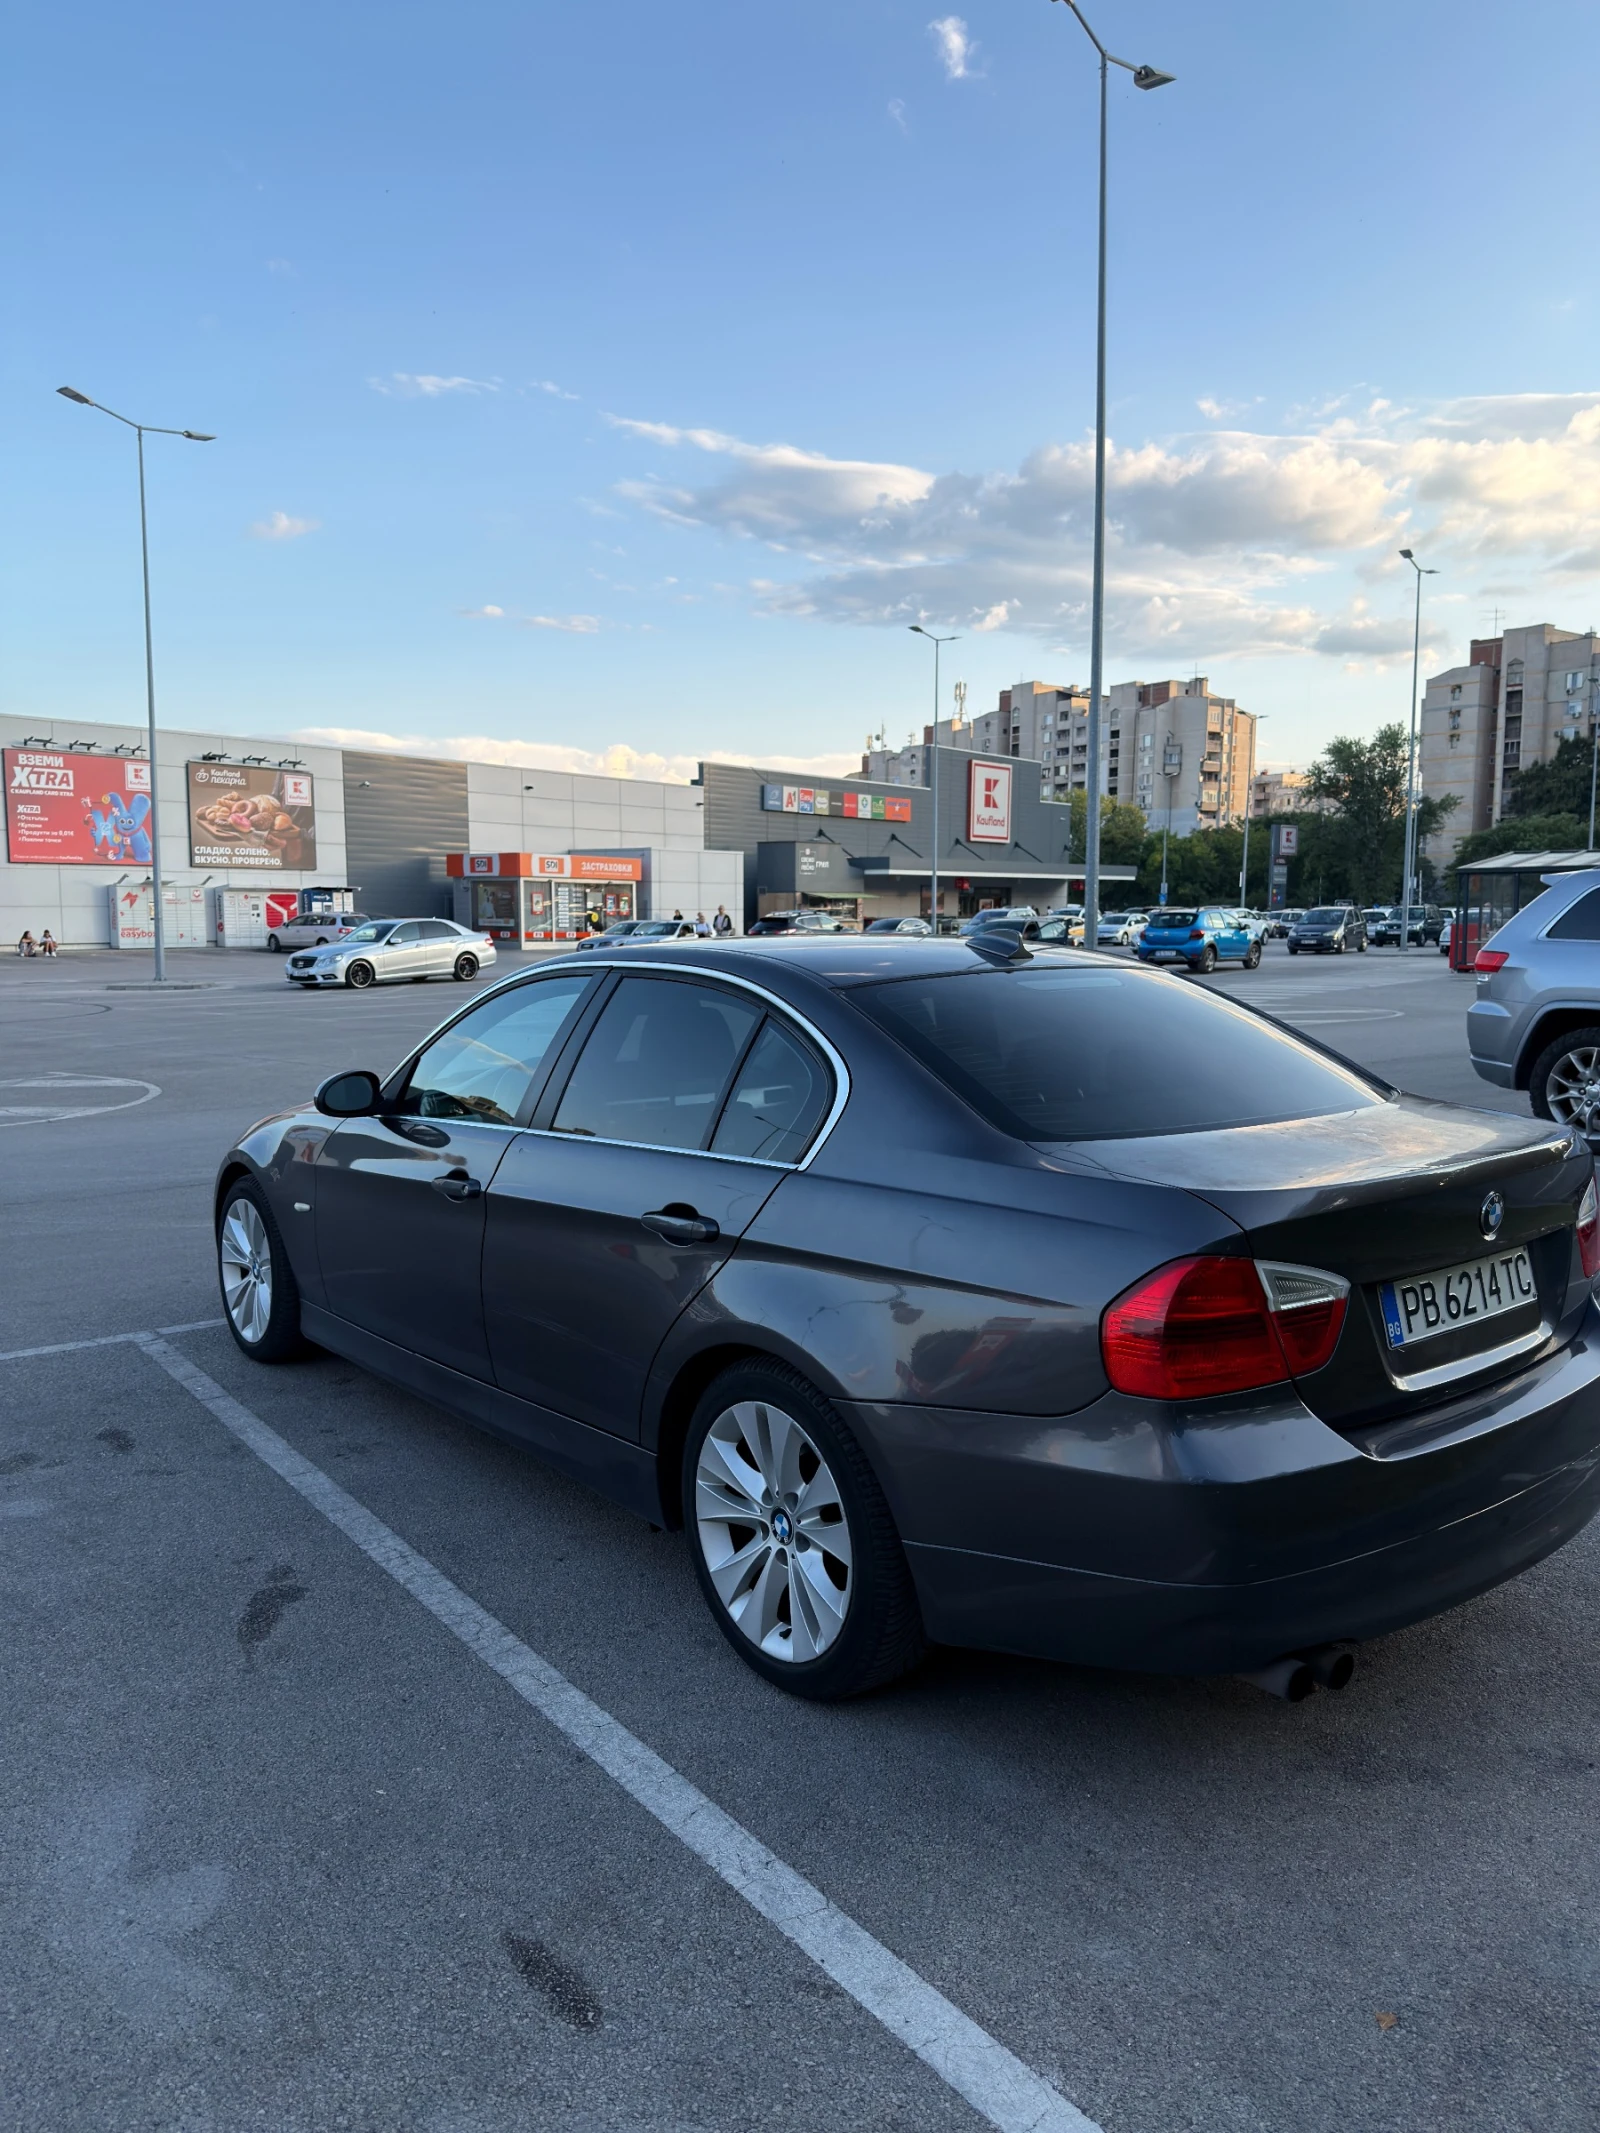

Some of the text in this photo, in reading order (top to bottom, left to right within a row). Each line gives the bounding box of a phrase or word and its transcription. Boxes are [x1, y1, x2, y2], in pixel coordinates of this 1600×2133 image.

[18, 753, 64, 768] ВЗЕМИ
[10, 766, 75, 790] XTRA
[211, 768, 241, 777] Kaufland
[211, 777, 248, 787] пекарна
[17, 805, 41, 814] XTRA
[976, 814, 1006, 828] Kaufland
[194, 846, 271, 857] СЛАДКО. СОЛЕНО.
[194, 855, 283, 866] ВКУСНО. ПРОВЕРЕНО.
[475, 860, 487, 869] SDI
[545, 860, 558, 869] SDI
[581, 861, 633, 873] ЗАСТРАХОВКИ
[1387, 1321, 1401, 1338] BG
